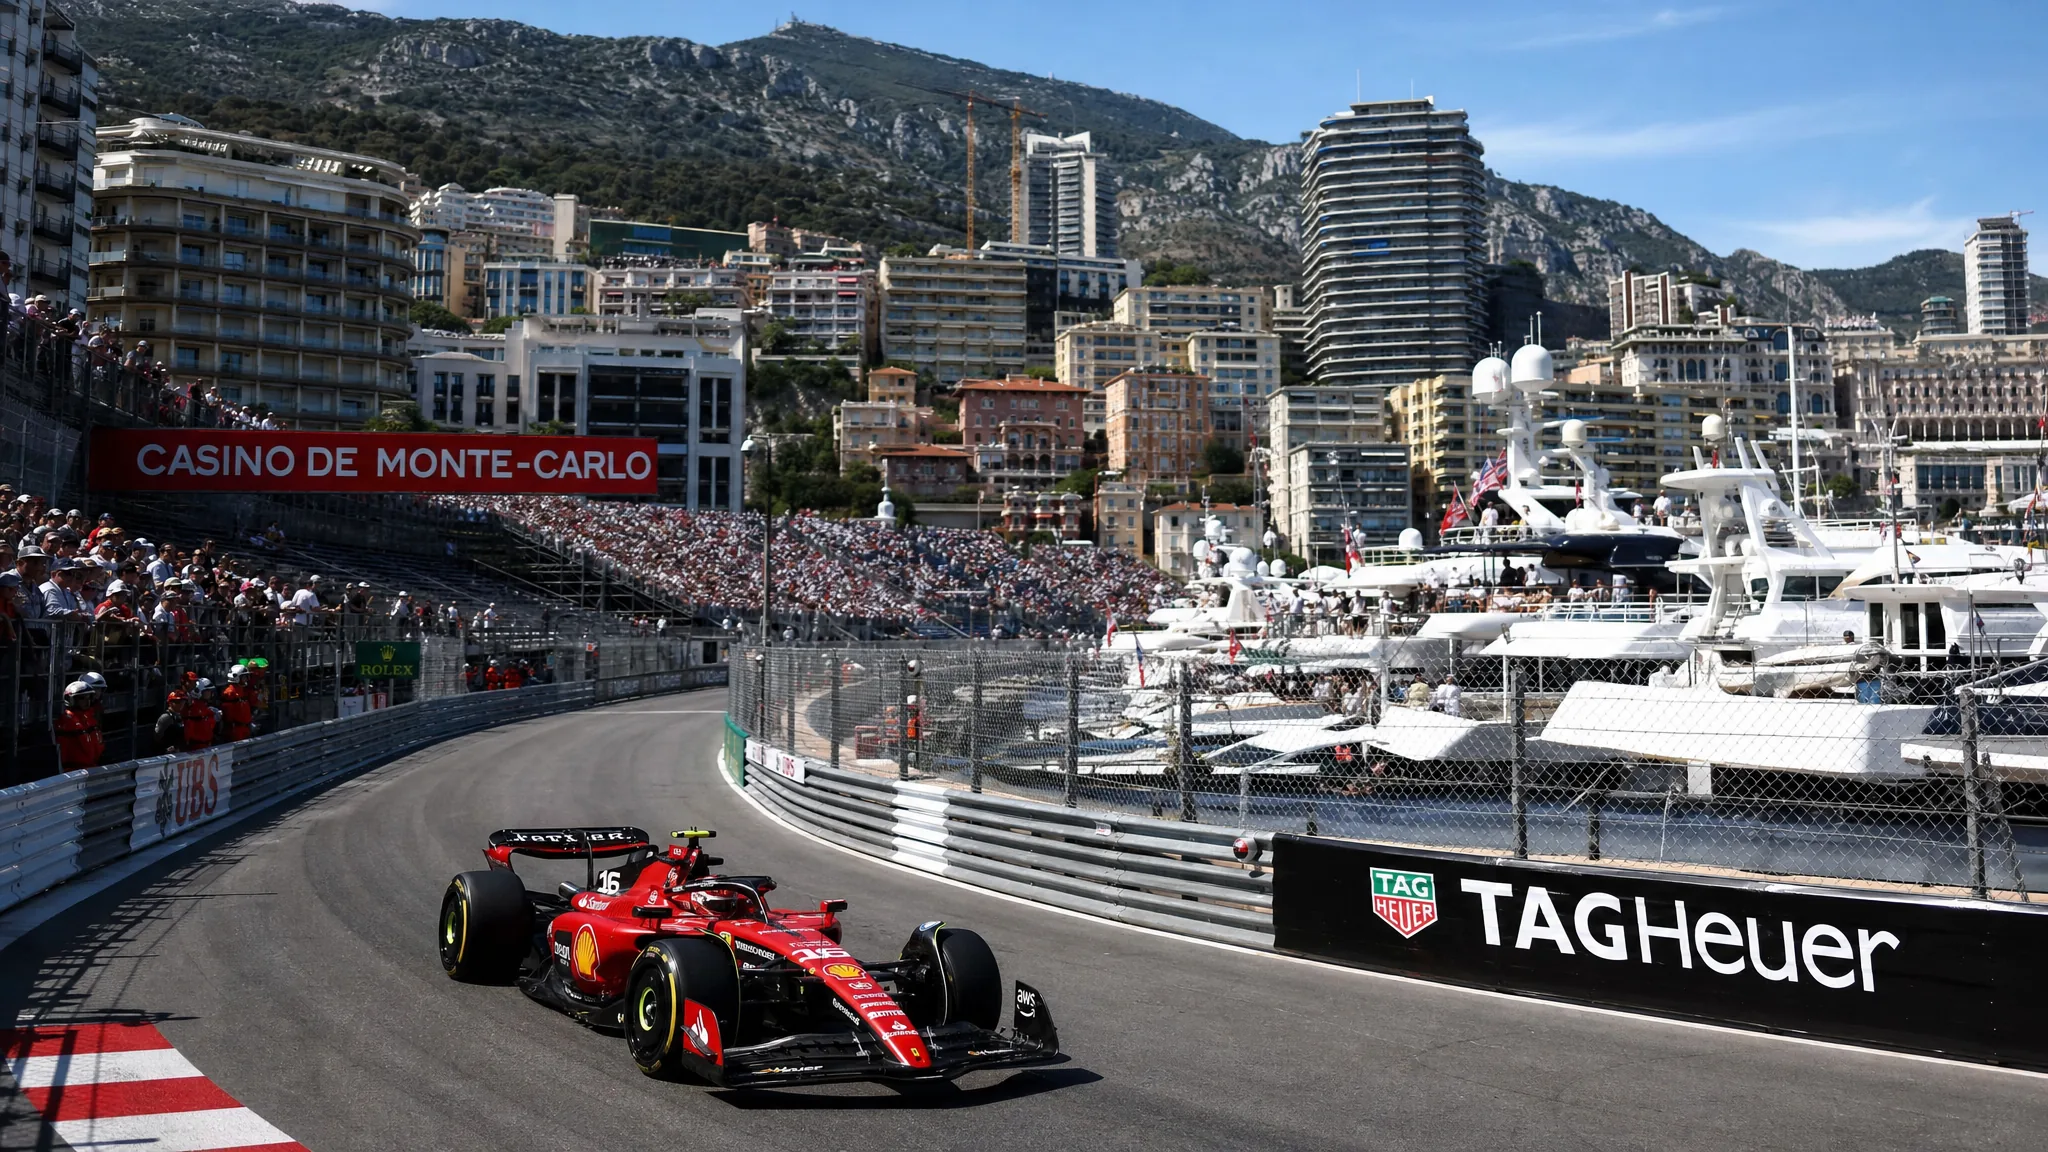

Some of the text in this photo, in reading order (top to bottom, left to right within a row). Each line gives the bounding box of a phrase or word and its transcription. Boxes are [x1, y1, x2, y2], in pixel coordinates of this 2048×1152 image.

[136, 443, 652, 481] CASINO DE MONTE-CARLO
[360, 664, 414, 676] ROLEX
[175, 753, 219, 827] UBS
[596, 869, 621, 895] 16
[1375, 872, 1429, 898] TAG
[1376, 898, 1434, 932] HEUER
[1016, 988, 1036, 1007] aws
